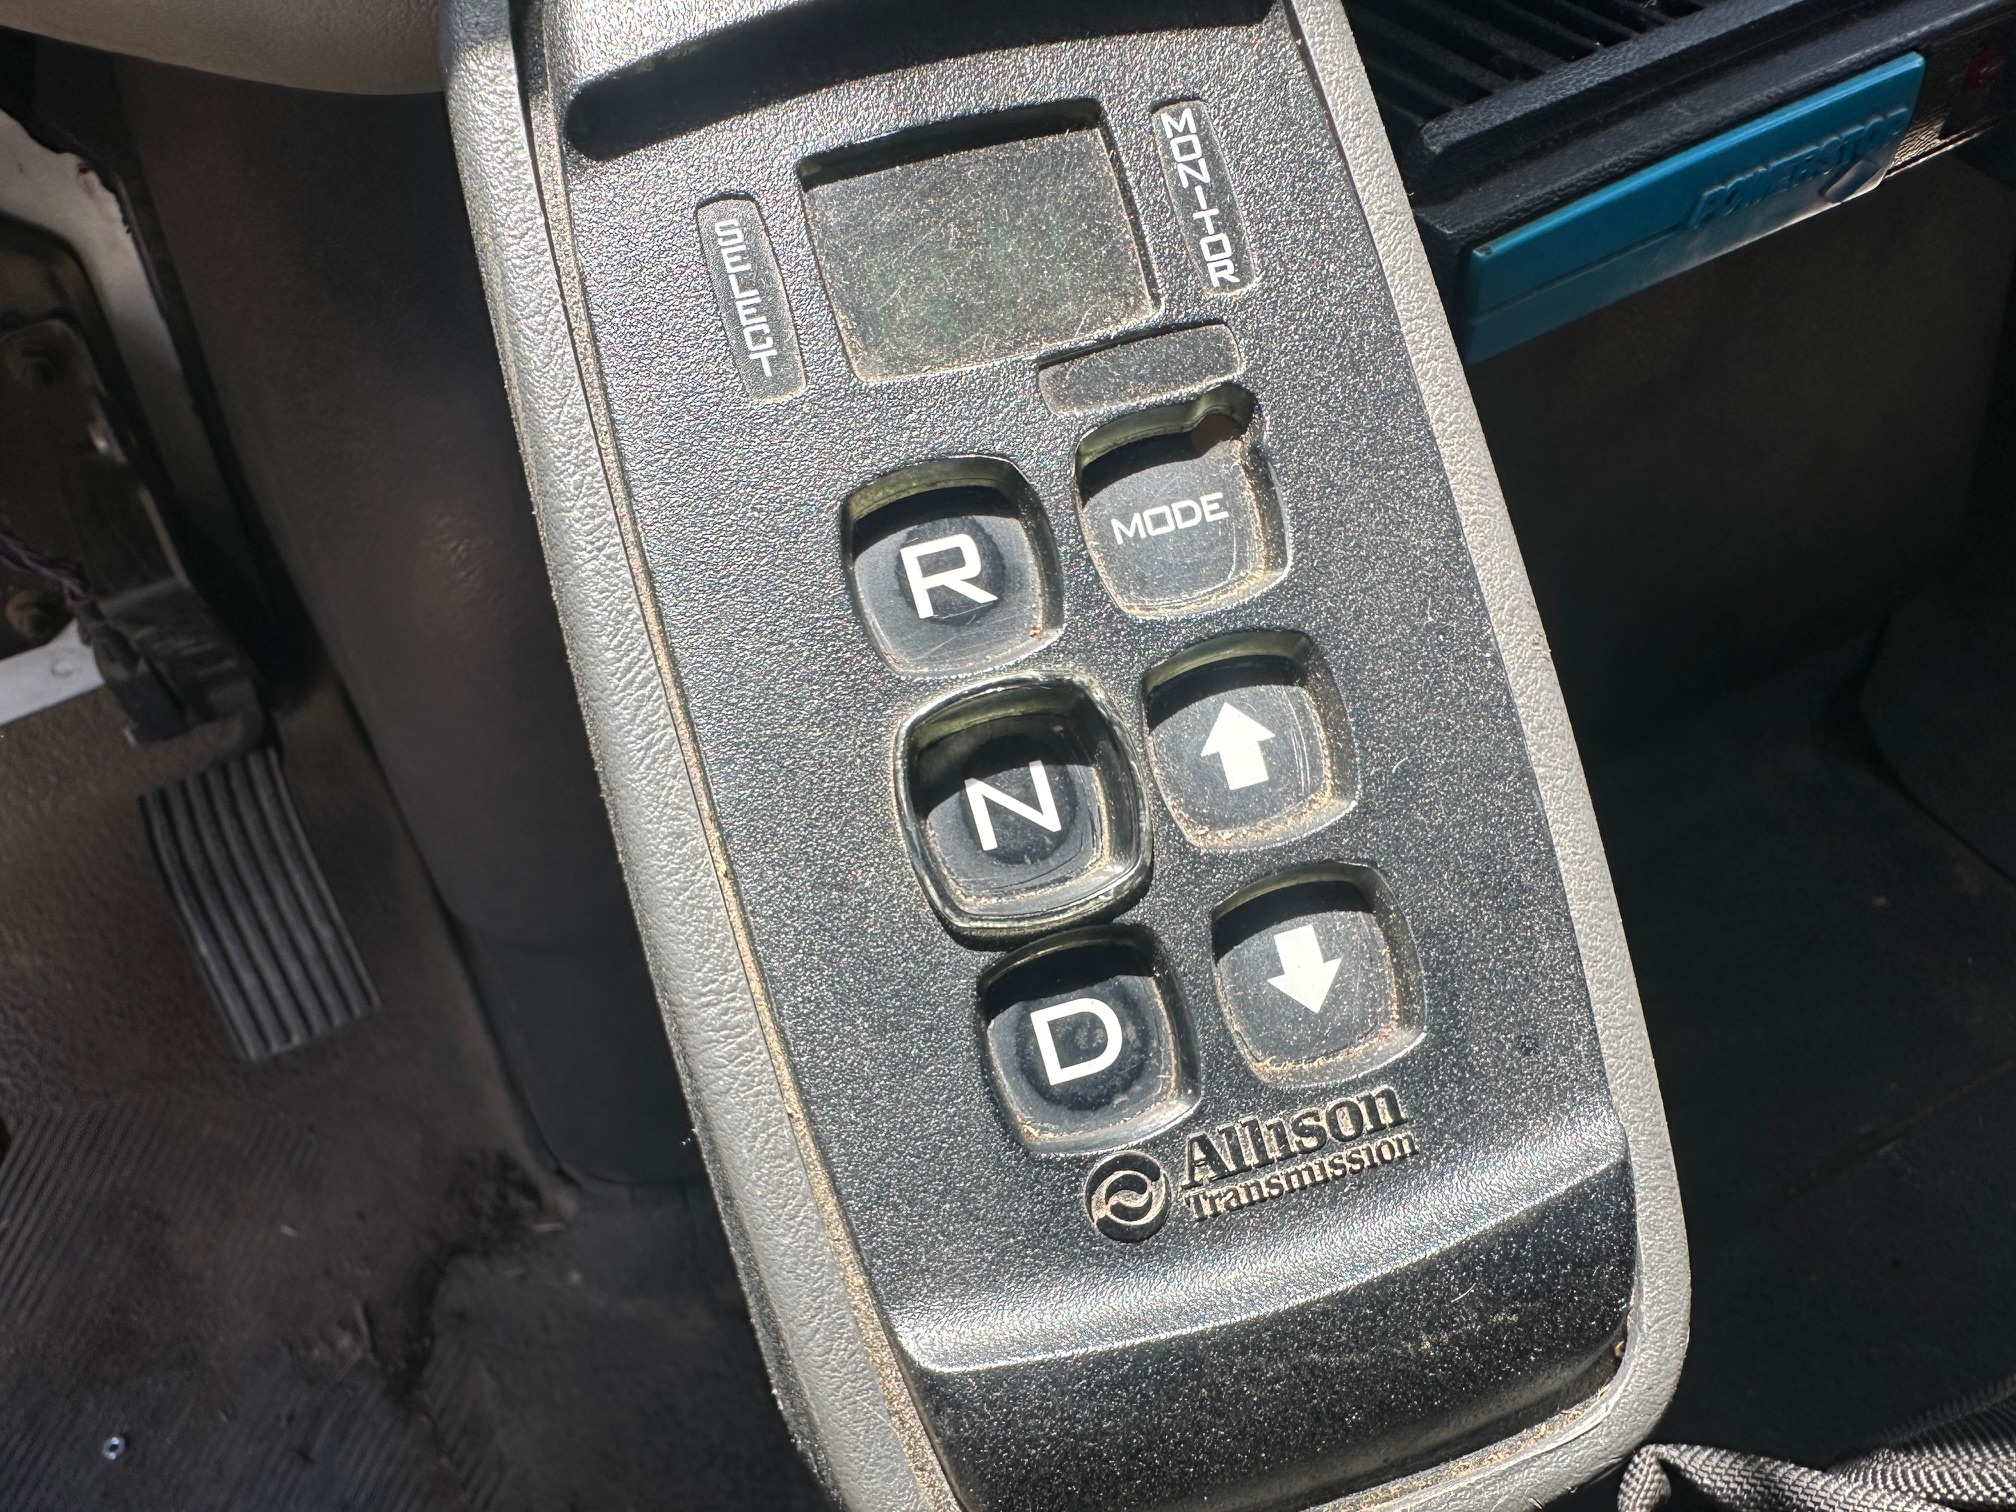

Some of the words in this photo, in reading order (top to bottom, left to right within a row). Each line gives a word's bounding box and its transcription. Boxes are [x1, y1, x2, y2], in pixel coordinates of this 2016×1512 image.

[1160, 106, 1240, 289] MONITOR
[714, 218, 778, 378] SELECT
[1111, 491, 1230, 545] MODE
[899, 533, 999, 620] R
[963, 759, 1062, 851] N
[1029, 997, 1123, 1087] D
[1180, 1085, 1408, 1190] Allison
[1182, 1132, 1420, 1222] Transmission
